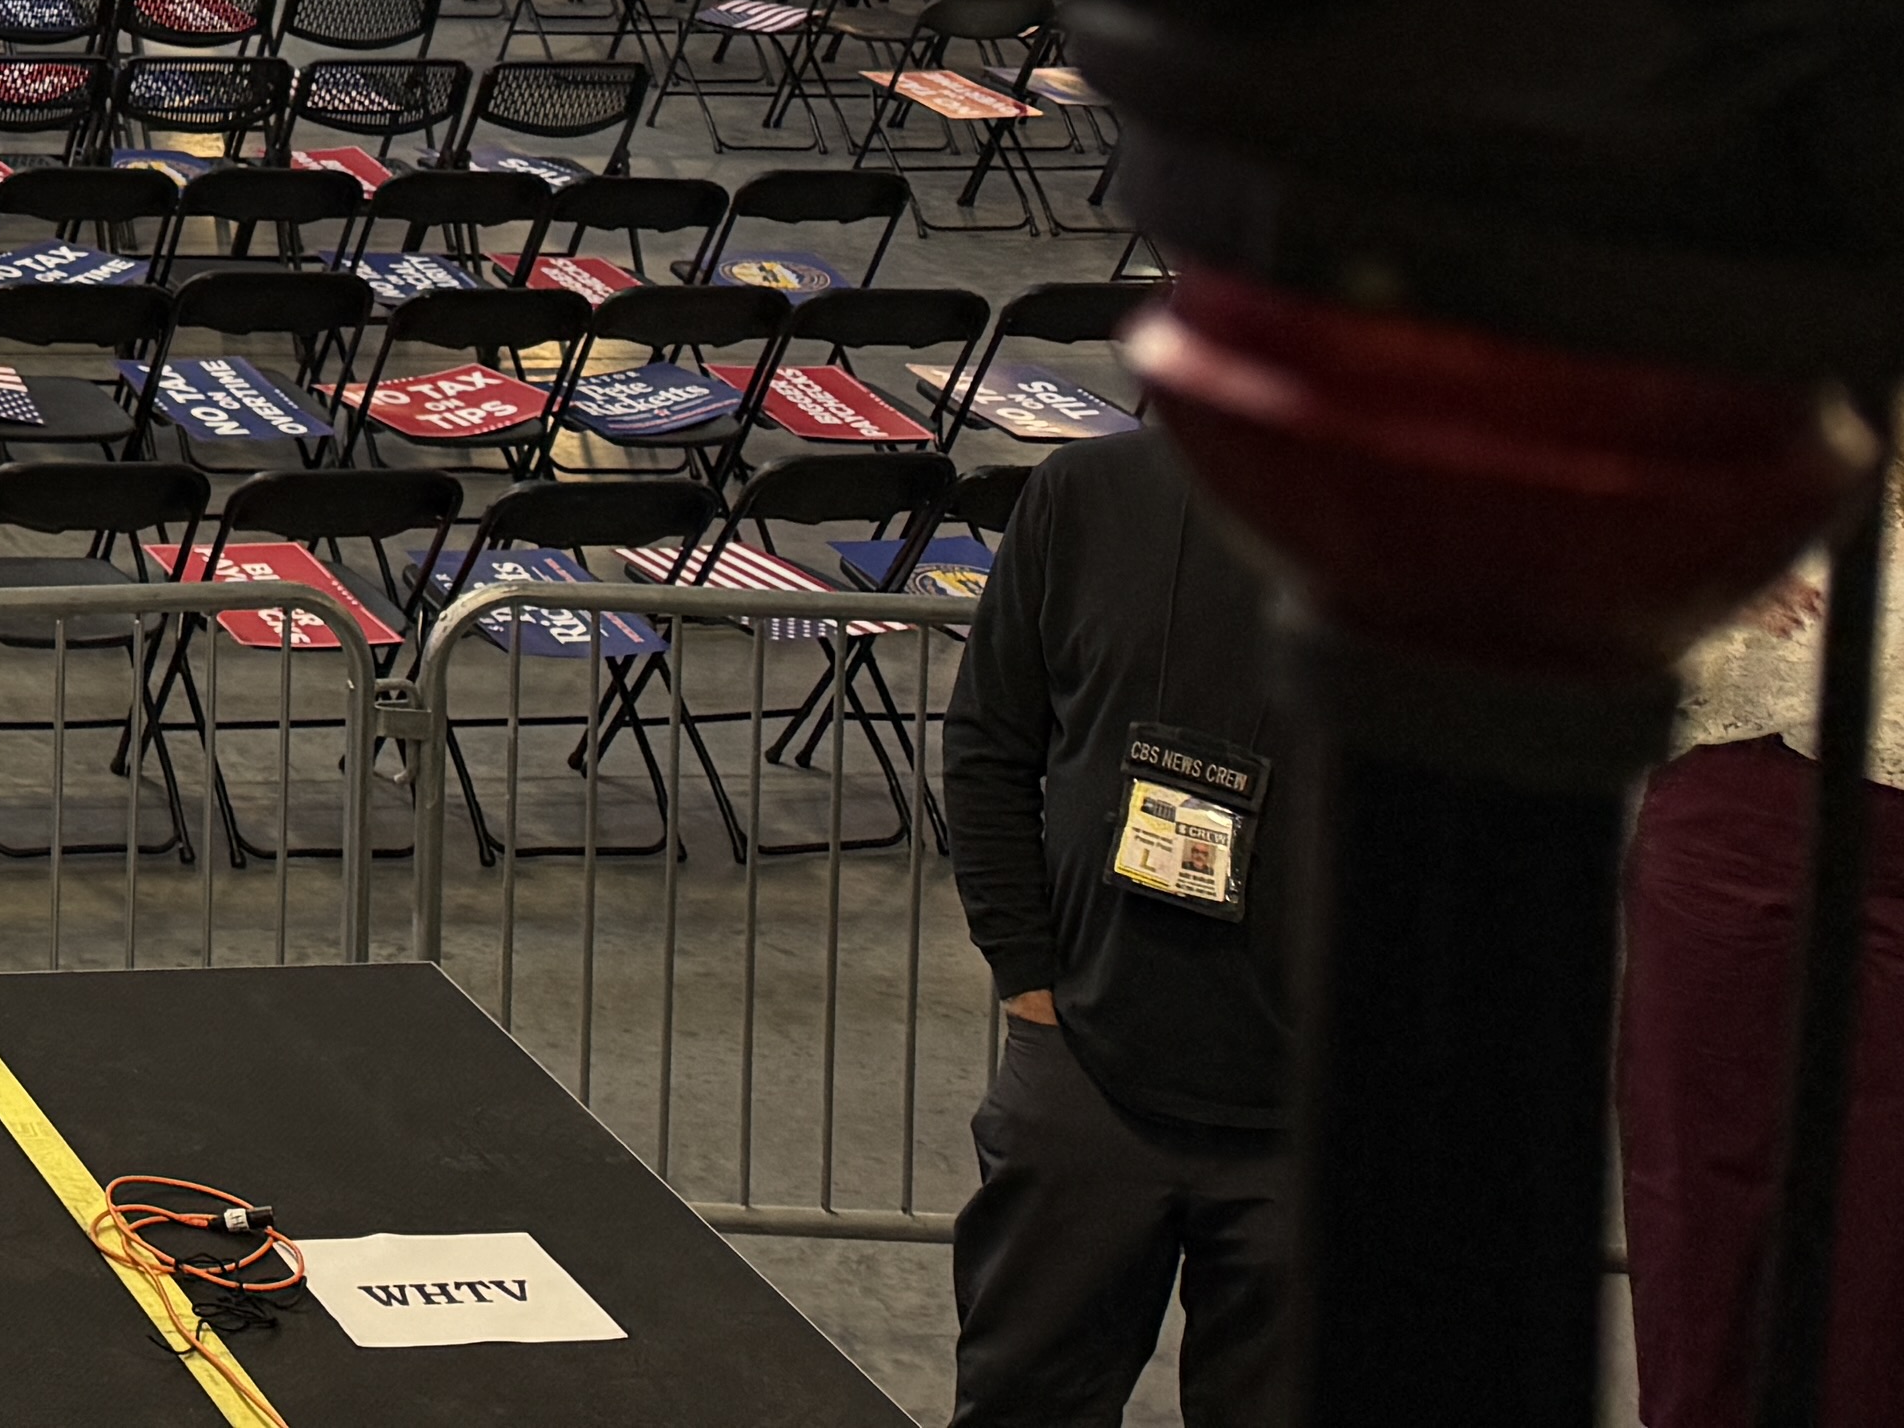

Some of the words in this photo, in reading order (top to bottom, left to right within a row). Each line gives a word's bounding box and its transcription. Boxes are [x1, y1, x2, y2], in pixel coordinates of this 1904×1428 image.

[13, 245, 89, 272] TAX
[35, 269, 68, 282] ON
[199, 358, 309, 435] OVERTIME
[407, 371, 502, 400] TAX
[579, 380, 649, 401] Pete
[207, 391, 240, 411] ON
[424, 398, 466, 412] ON
[574, 385, 711, 417] Ricketts
[770, 379, 842, 425] BIGGER
[777, 367, 889, 438] PAYCHECKS
[1017, 381, 1100, 420] TIPS
[190, 406, 251, 436] NO
[416, 401, 518, 431] TIPS
[996, 407, 1061, 433] NO
[1130, 741, 1160, 764] CBS
[1162, 749, 1203, 777] NEWS
[1205, 764, 1248, 791] CREW
[357, 1280, 527, 1307] WHTV
